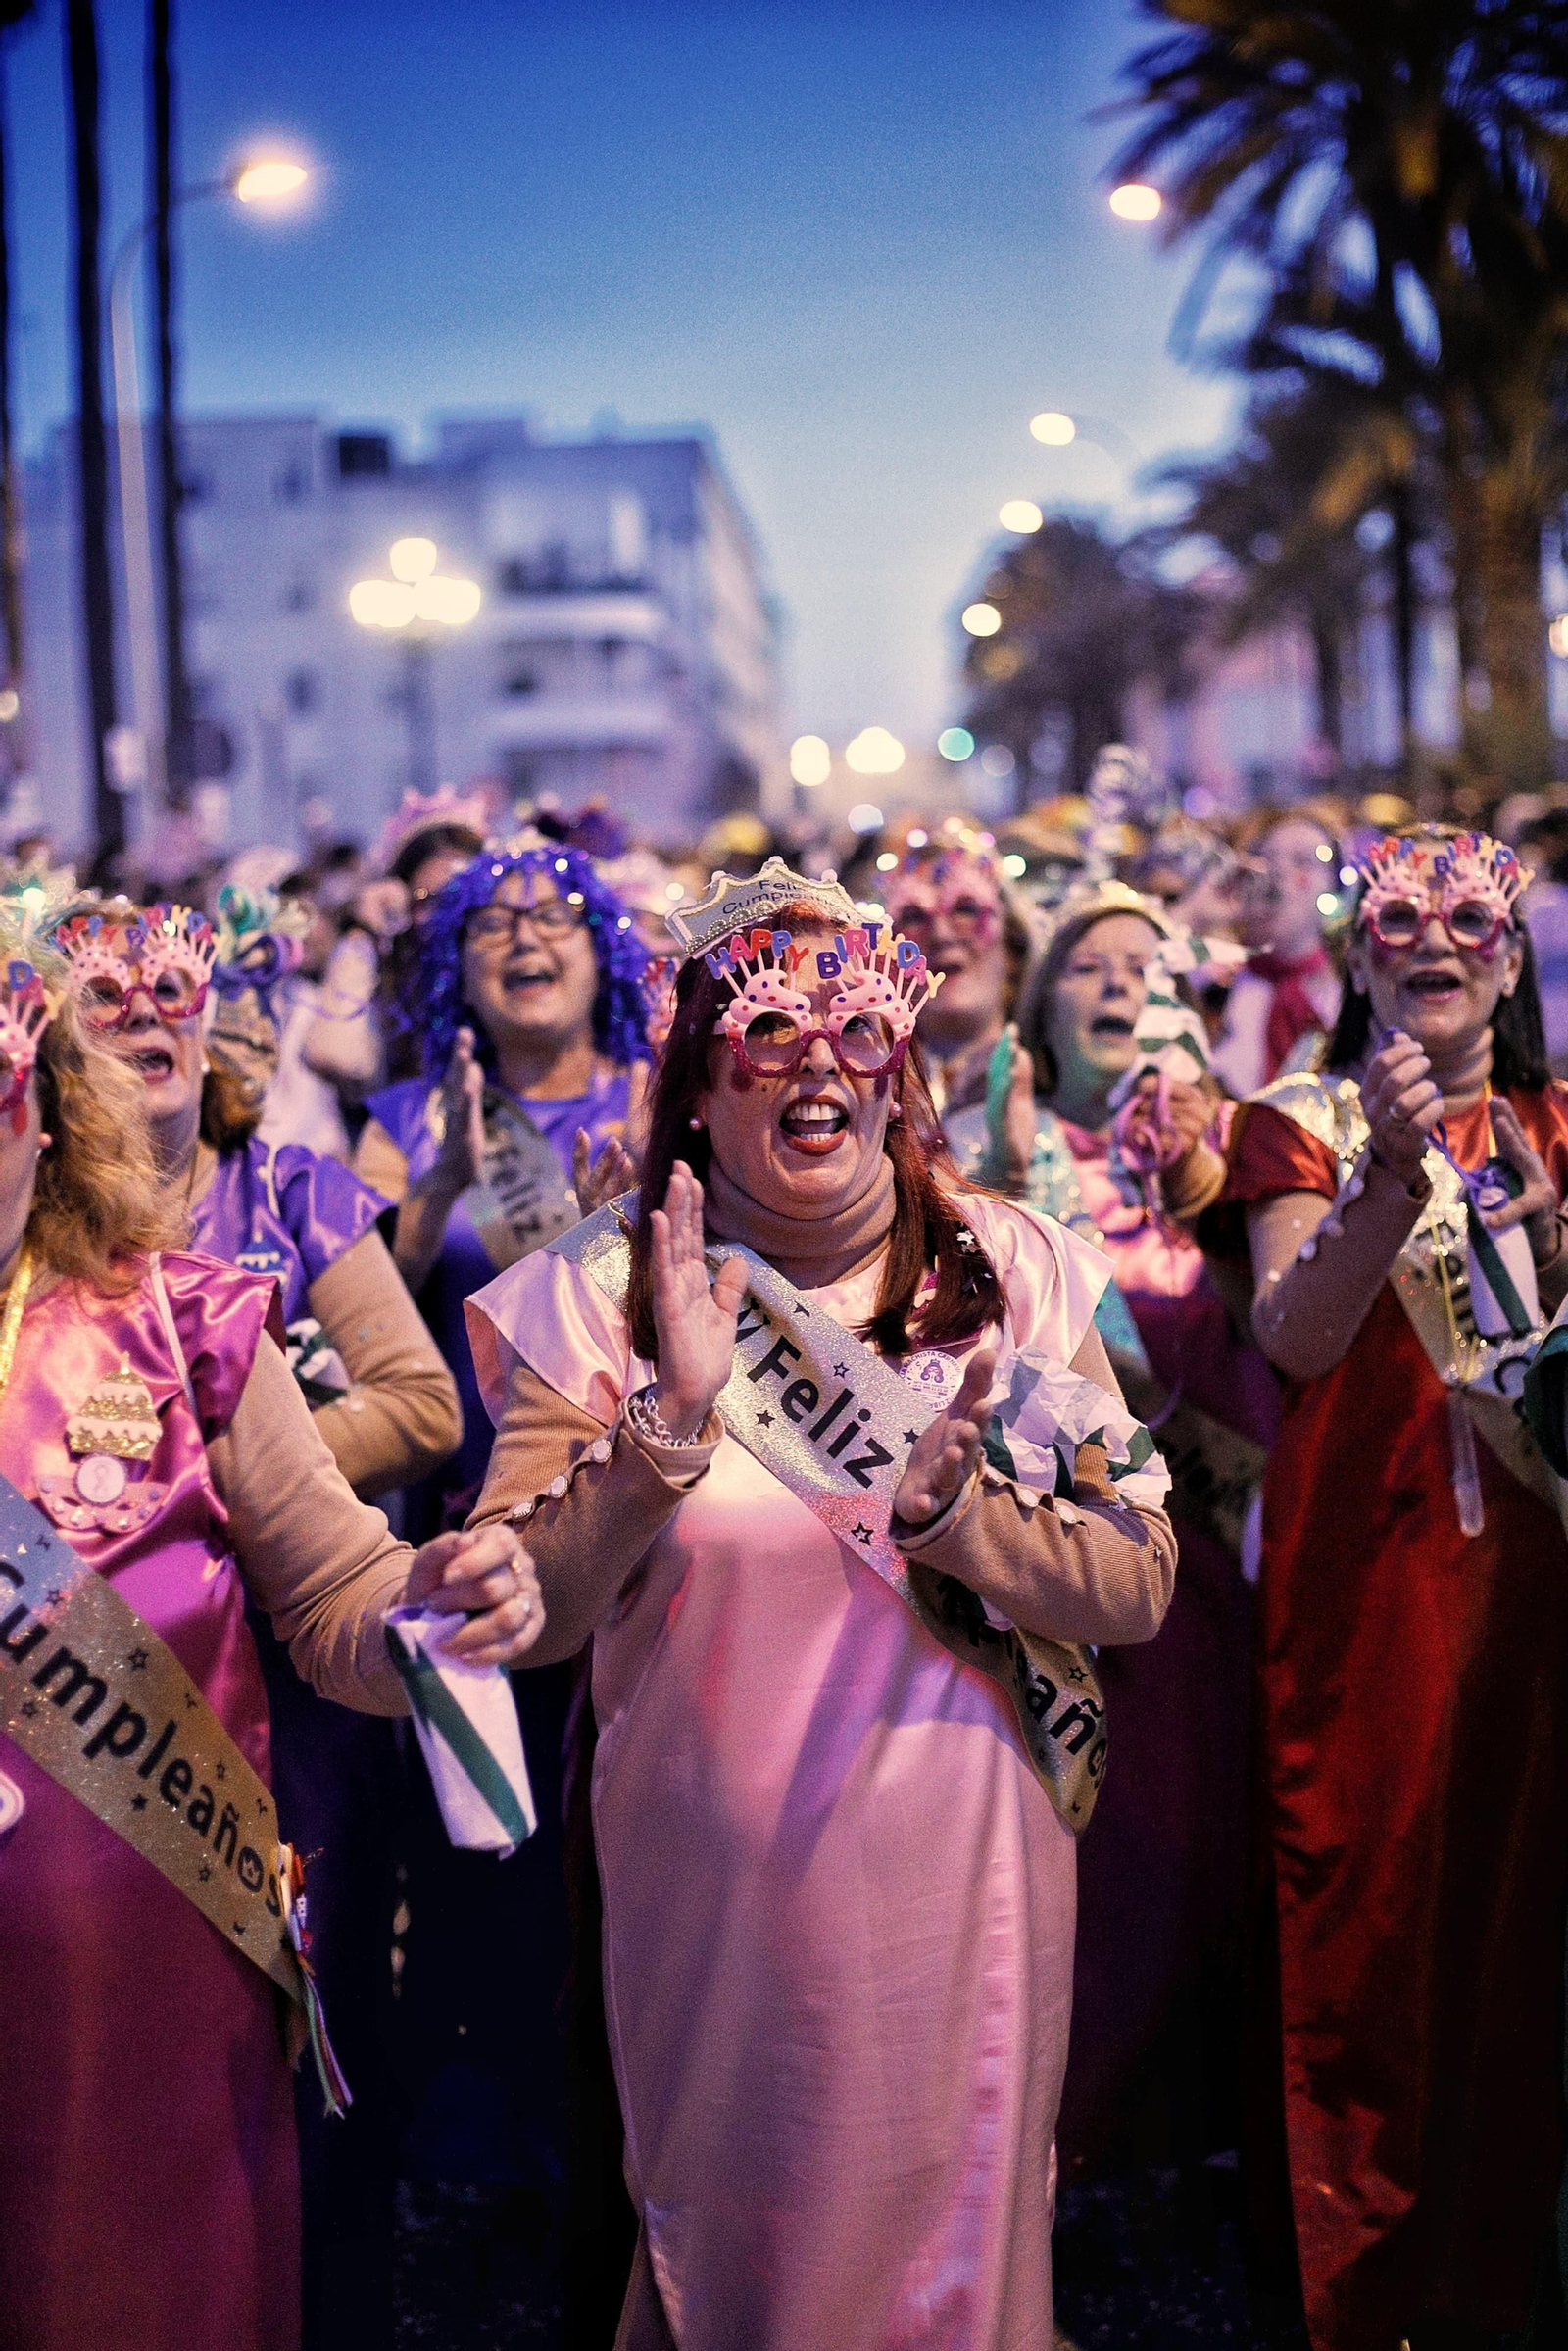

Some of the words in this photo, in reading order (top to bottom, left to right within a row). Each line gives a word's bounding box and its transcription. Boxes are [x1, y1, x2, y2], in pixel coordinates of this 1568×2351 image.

[705, 929, 809, 980] HAPPY
[816, 922, 946, 998] BIRTHDAY
[747, 1335, 894, 1489] Feliz
